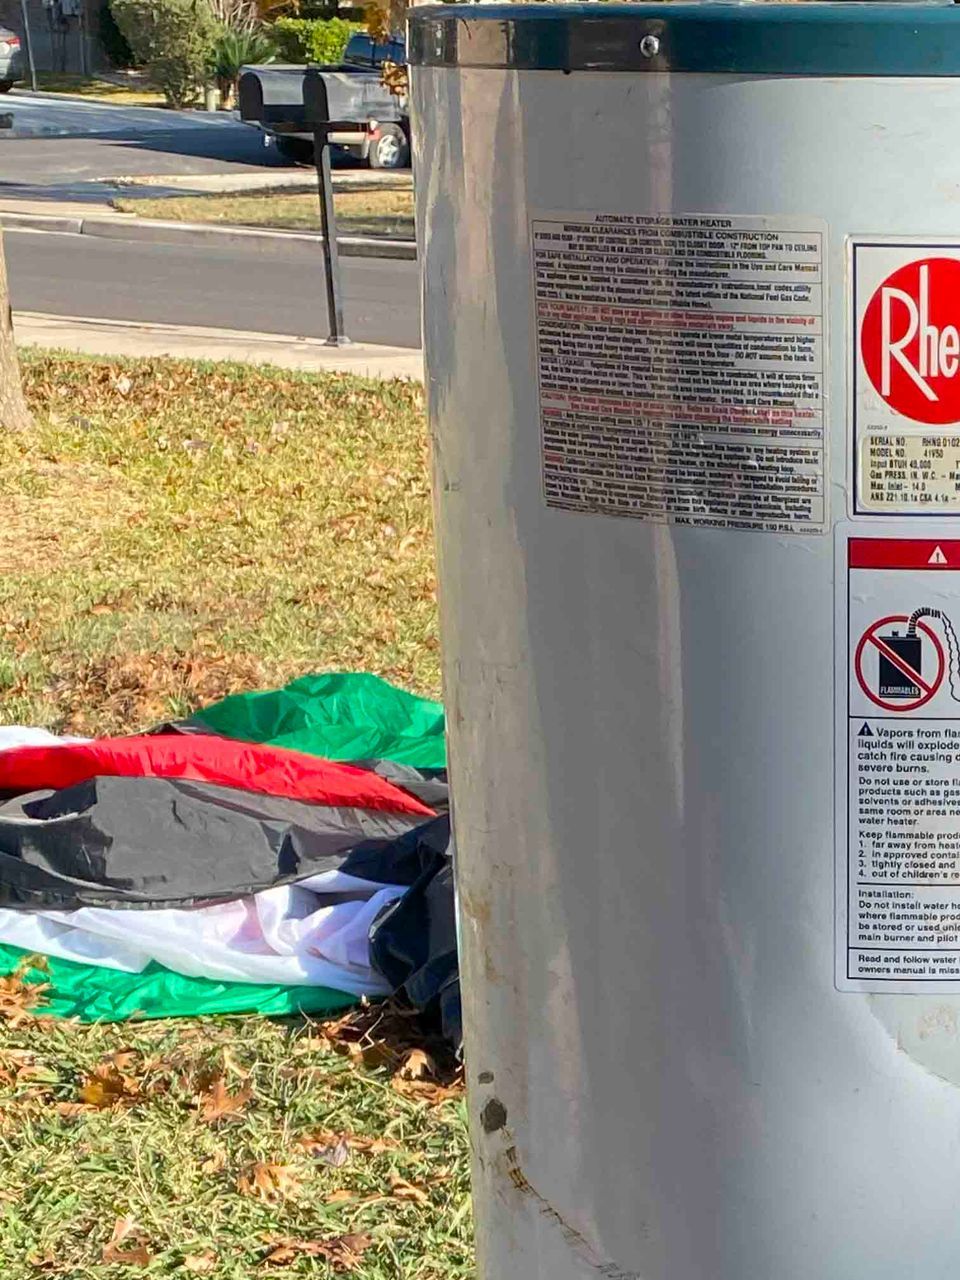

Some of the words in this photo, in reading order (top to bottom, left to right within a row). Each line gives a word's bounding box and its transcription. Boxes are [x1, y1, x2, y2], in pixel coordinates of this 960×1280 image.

[596, 215, 634, 224] AUTOMATIC
[716, 233, 778, 241] CONSTRUCTION
[870, 437, 893, 446] SERIAL
[870, 448, 892, 457] MODEL
[870, 460, 887, 469] Input
[870, 471, 882, 479] Gas
[693, 518, 725, 527] WORKING
[876, 728, 913, 739] Vapors
[917, 728, 941, 737] from
[858, 739, 893, 750] liquids
[897, 740, 914, 749] will
[918, 740, 959, 751] explode
[858, 752, 886, 761] catch
[890, 752, 906, 761] fire
[910, 753, 952, 763] causing
[858, 764, 893, 772] severe
[896, 764, 929, 773] burns.
[859, 777, 871, 785] Do
[859, 788, 900, 796] products
[904, 788, 927, 796] such
[859, 831, 882, 840] Keep
[885, 831, 934, 839] flammable
